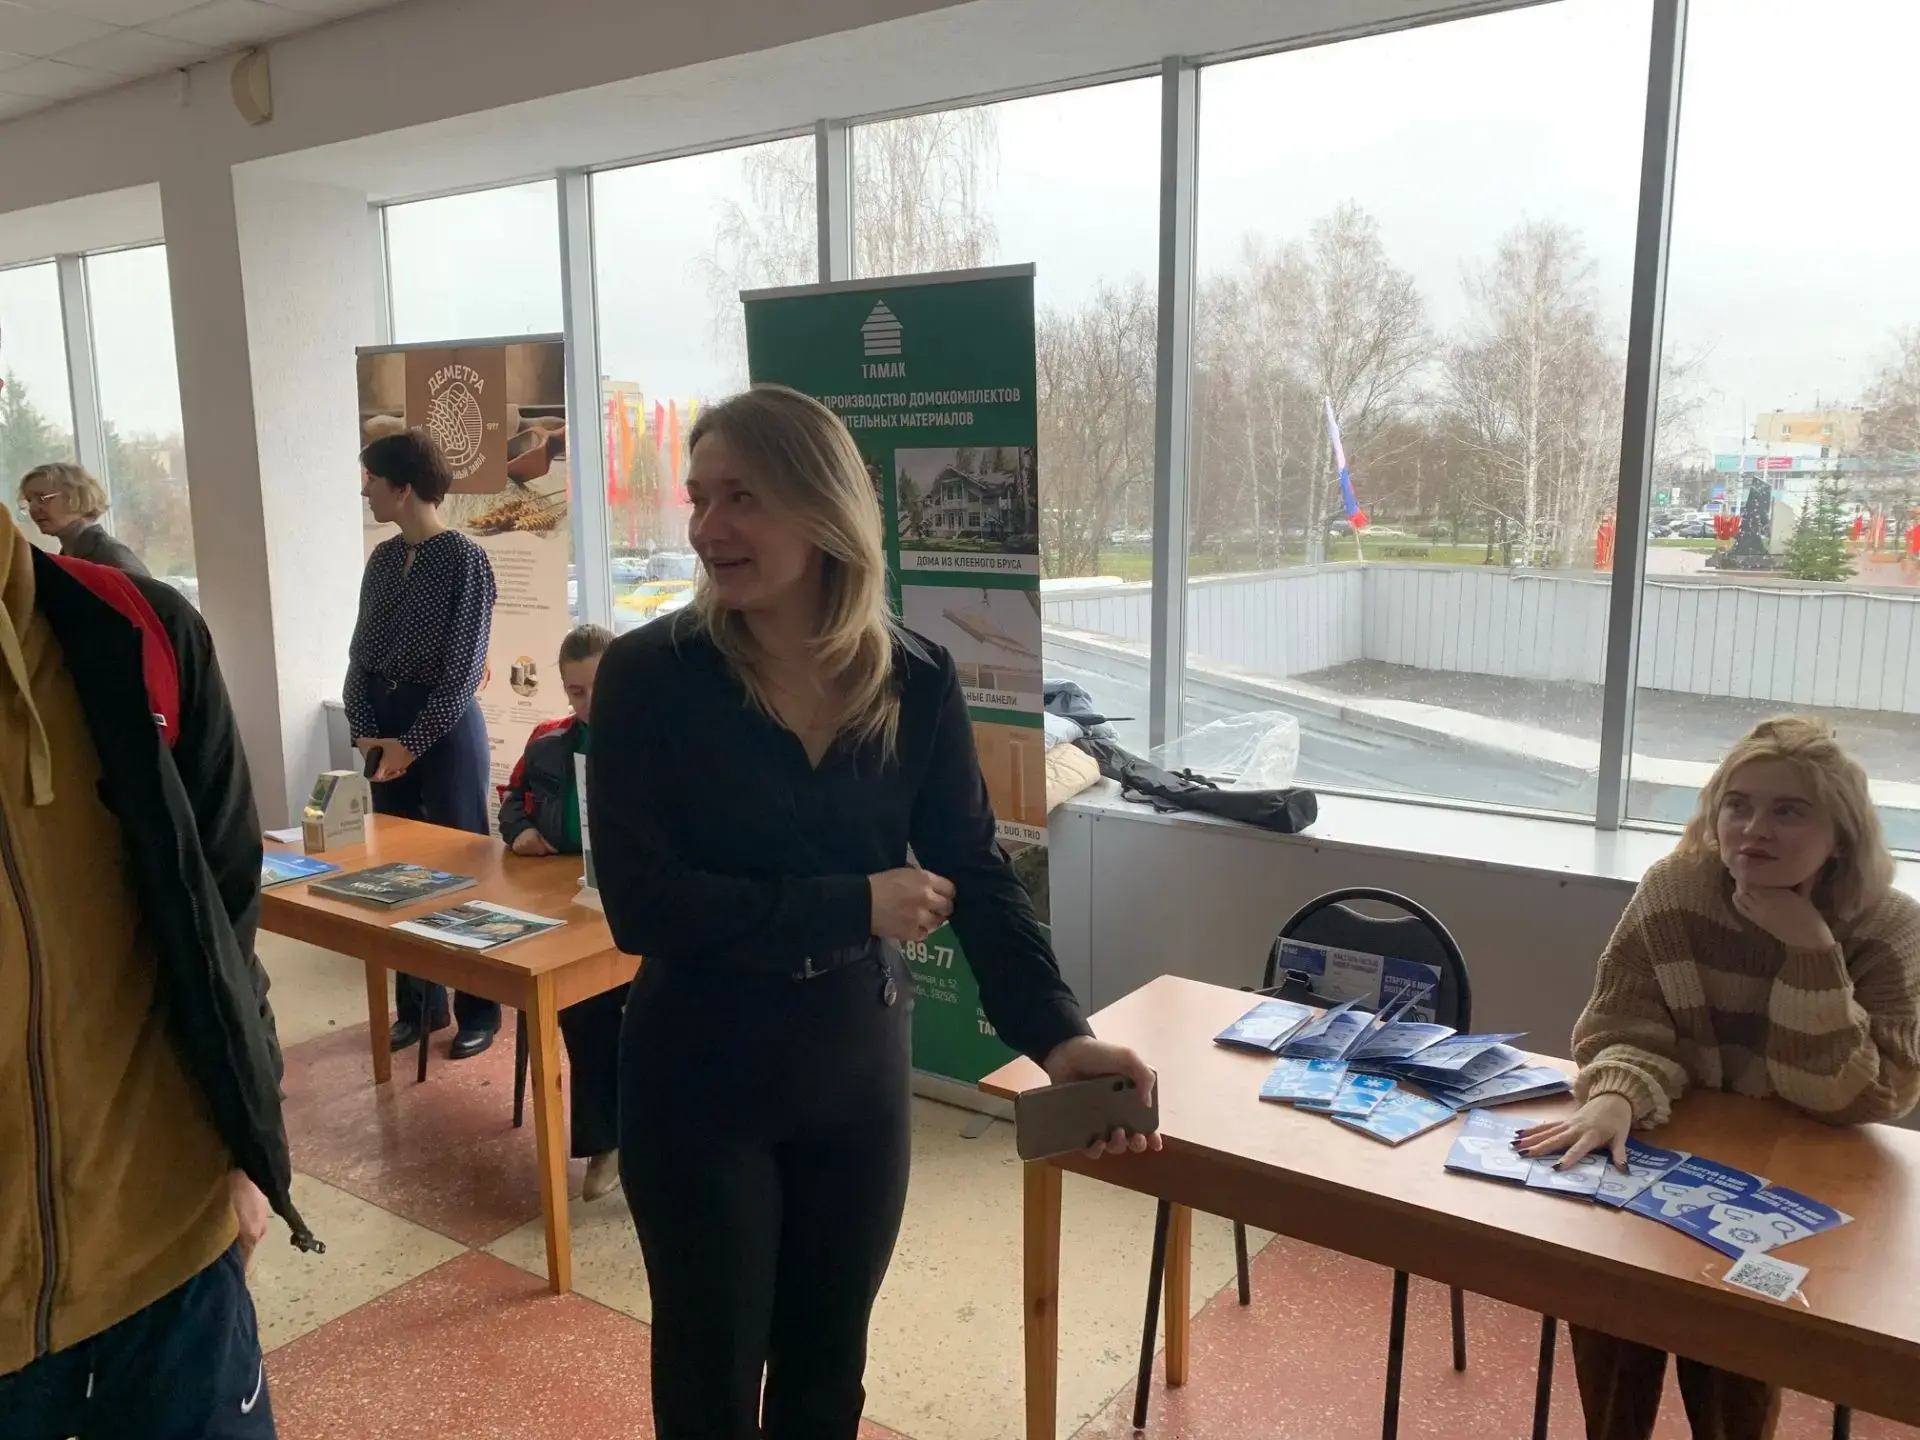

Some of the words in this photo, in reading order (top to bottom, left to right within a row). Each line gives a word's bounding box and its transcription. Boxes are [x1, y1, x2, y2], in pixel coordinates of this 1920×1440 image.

[861, 362, 906, 379] ТАМАК
[428, 365, 485, 395] ДЕМЕТРА
[824, 392, 906, 410] ПРОИЗВОДСТВО
[909, 388, 1021, 408] ДОМОКОМПЛЕКТОВ
[840, 413, 898, 429] ИТЕЛЬНЫХ
[900, 411, 974, 427] МАТЕРИАЛОВ
[916, 555, 940, 567] ДОМА
[941, 556, 953, 567] ИЗ
[954, 557, 995, 569] КЛЕЕНОГО
[997, 559, 1022, 570] БРУСА
[986, 693, 1019, 706] ПАНЕЛИ
[1023, 829, 1041, 840] TRIO
